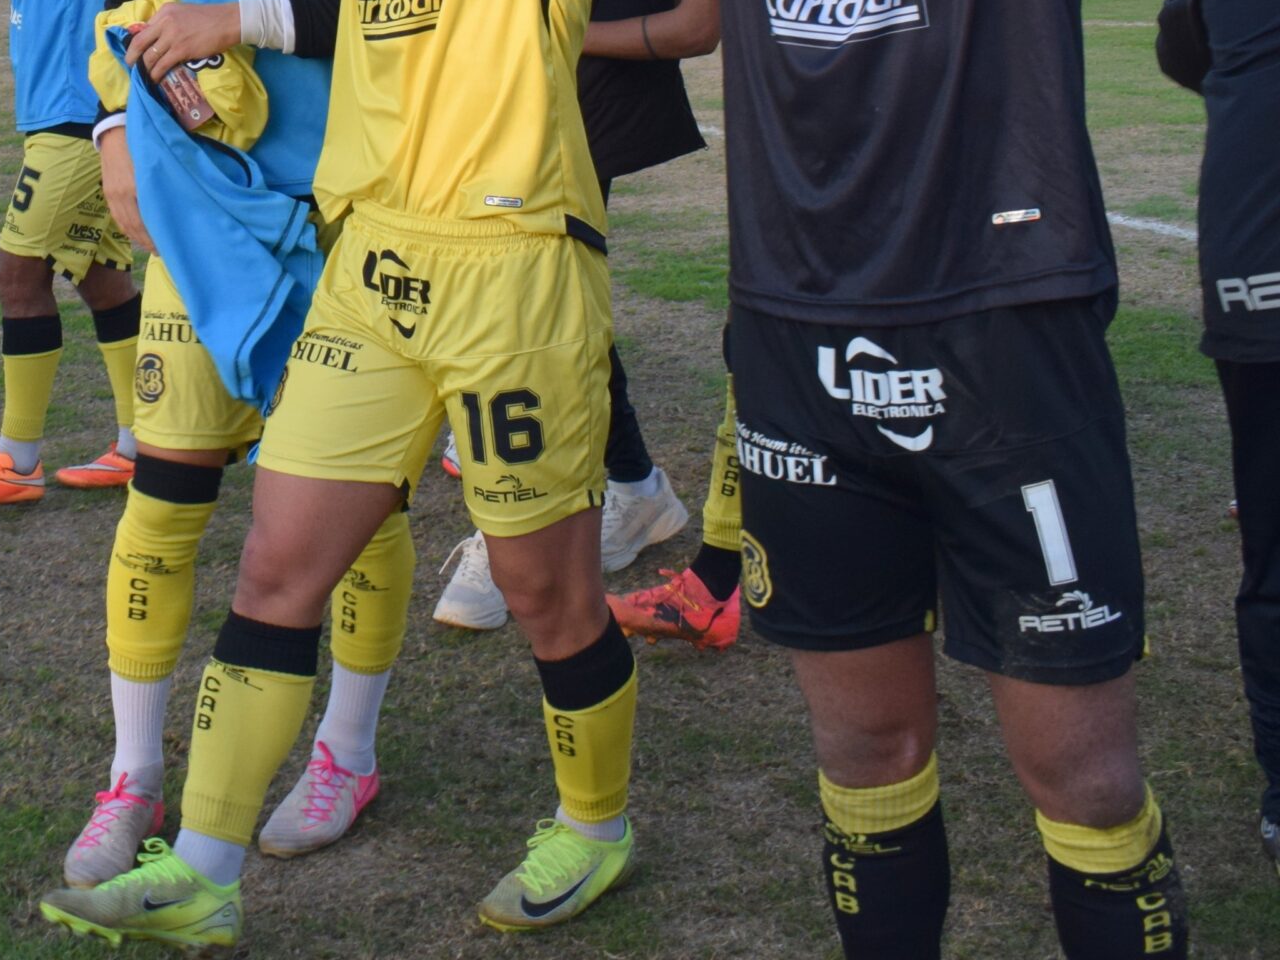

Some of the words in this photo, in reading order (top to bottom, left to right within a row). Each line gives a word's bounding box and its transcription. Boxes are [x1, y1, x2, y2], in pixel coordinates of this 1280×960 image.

[12, 165, 42, 214] 5
[1216, 272, 1280, 313] RE
[817, 346, 948, 406] LIDER
[460, 386, 546, 466] 16
[851, 402, 946, 420] ELECTRONICA
[474, 486, 548, 504] RETIEL
[1021, 479, 1078, 586] 1
[128, 578, 148, 621] CAB
[1019, 604, 1122, 633] RETIEL
[197, 676, 221, 731] CAB
[831, 852, 860, 914] CAB
[1136, 892, 1173, 954] CAB
